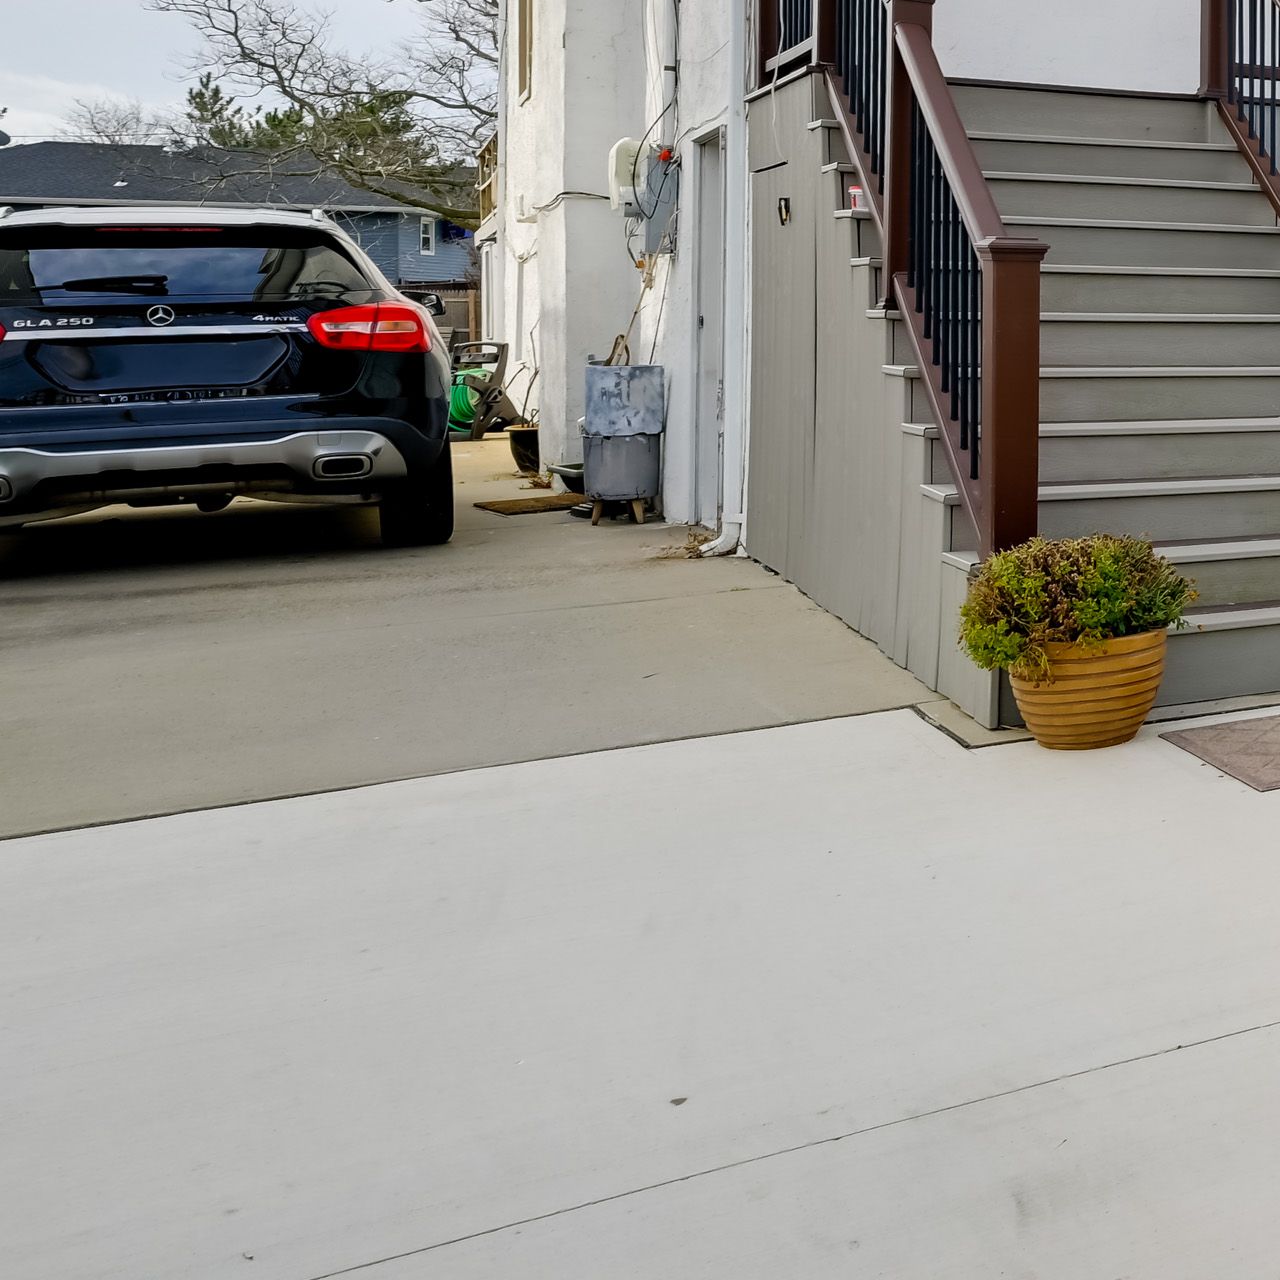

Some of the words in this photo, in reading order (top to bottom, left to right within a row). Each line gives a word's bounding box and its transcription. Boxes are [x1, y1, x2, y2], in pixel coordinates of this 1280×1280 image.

[13, 319, 52, 328] GLA
[56, 317, 94, 326] 250
[252, 314, 300, 322] 4MATIC
